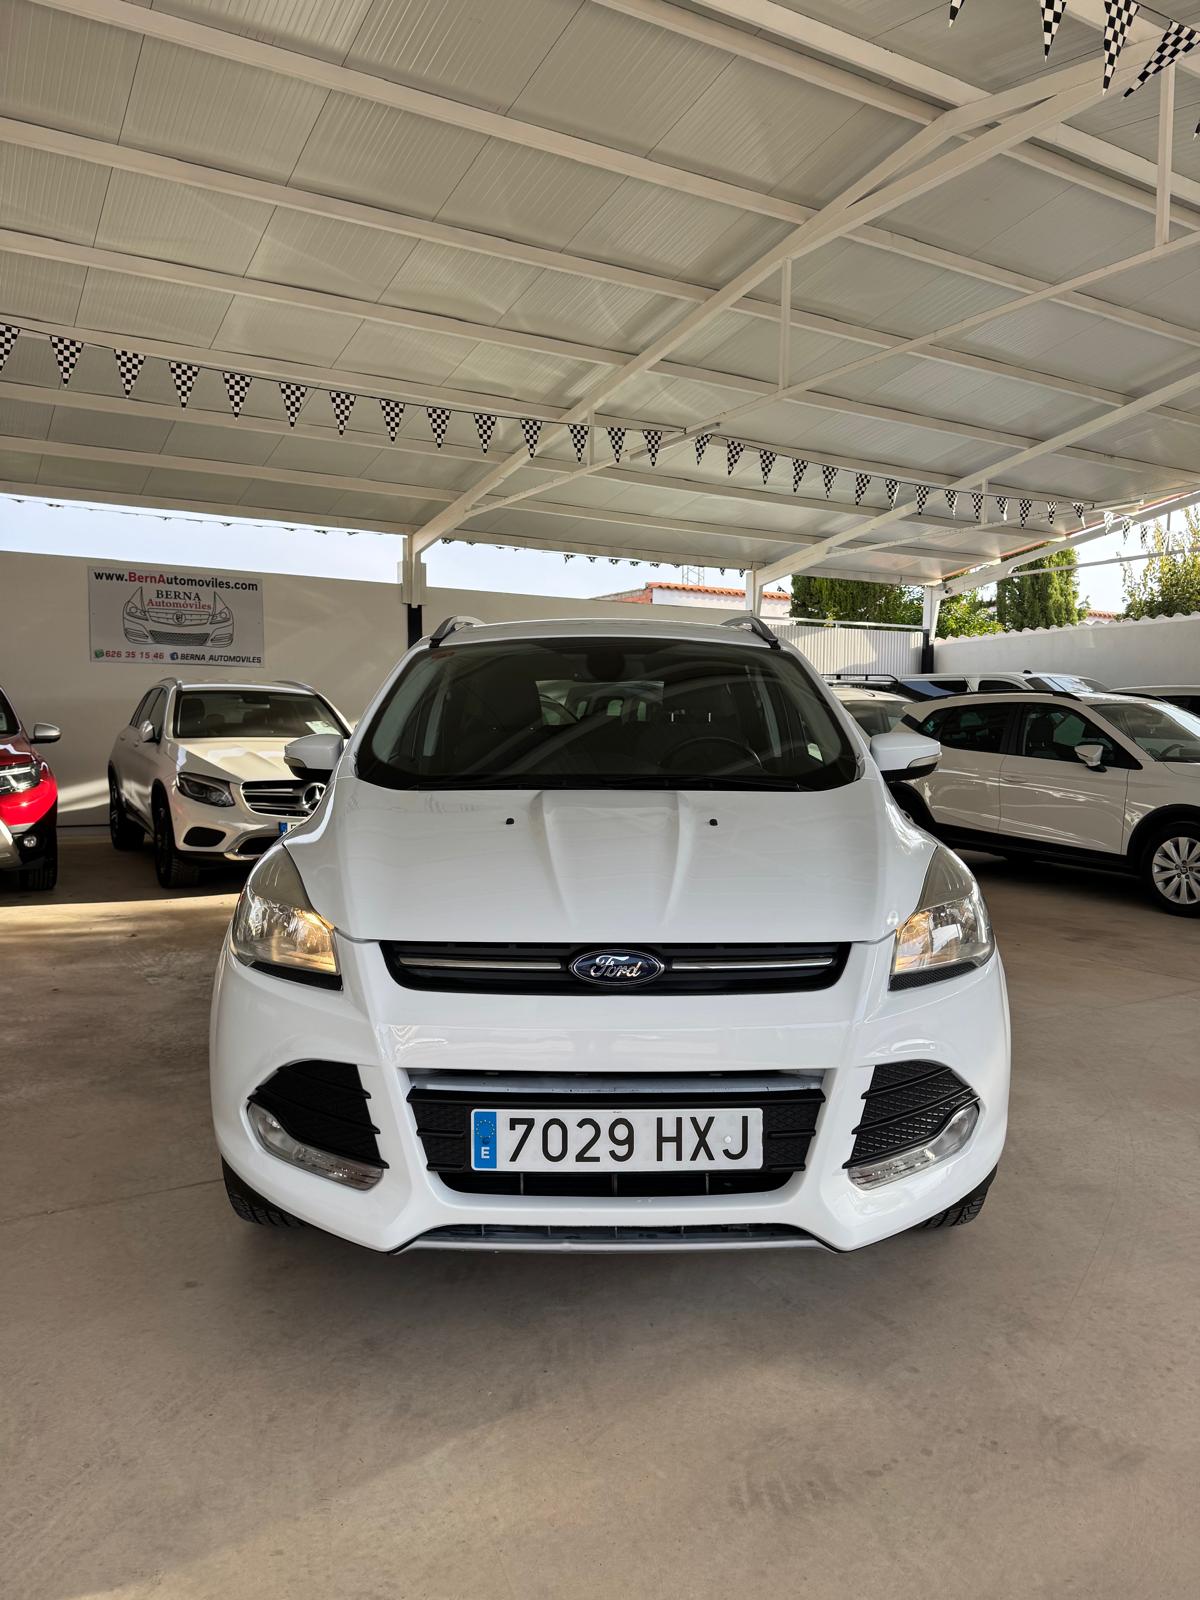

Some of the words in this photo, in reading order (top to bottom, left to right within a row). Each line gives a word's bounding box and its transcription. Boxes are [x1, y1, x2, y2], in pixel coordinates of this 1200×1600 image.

[94, 571, 258, 592] www.BernAutomoviles.com
[156, 589, 201, 601] BERNA
[147, 599, 211, 610] Automóviles
[105, 650, 122, 658] 626
[125, 651, 136, 659] 35
[140, 651, 150, 659] 15
[180, 653, 206, 661] BERNA
[208, 654, 262, 664] AUTOMOVILES
[590, 955, 643, 977] Ford
[509, 1117, 635, 1162] 7029
[656, 1115, 749, 1161] HXJ
[480, 1146, 490, 1159] E
